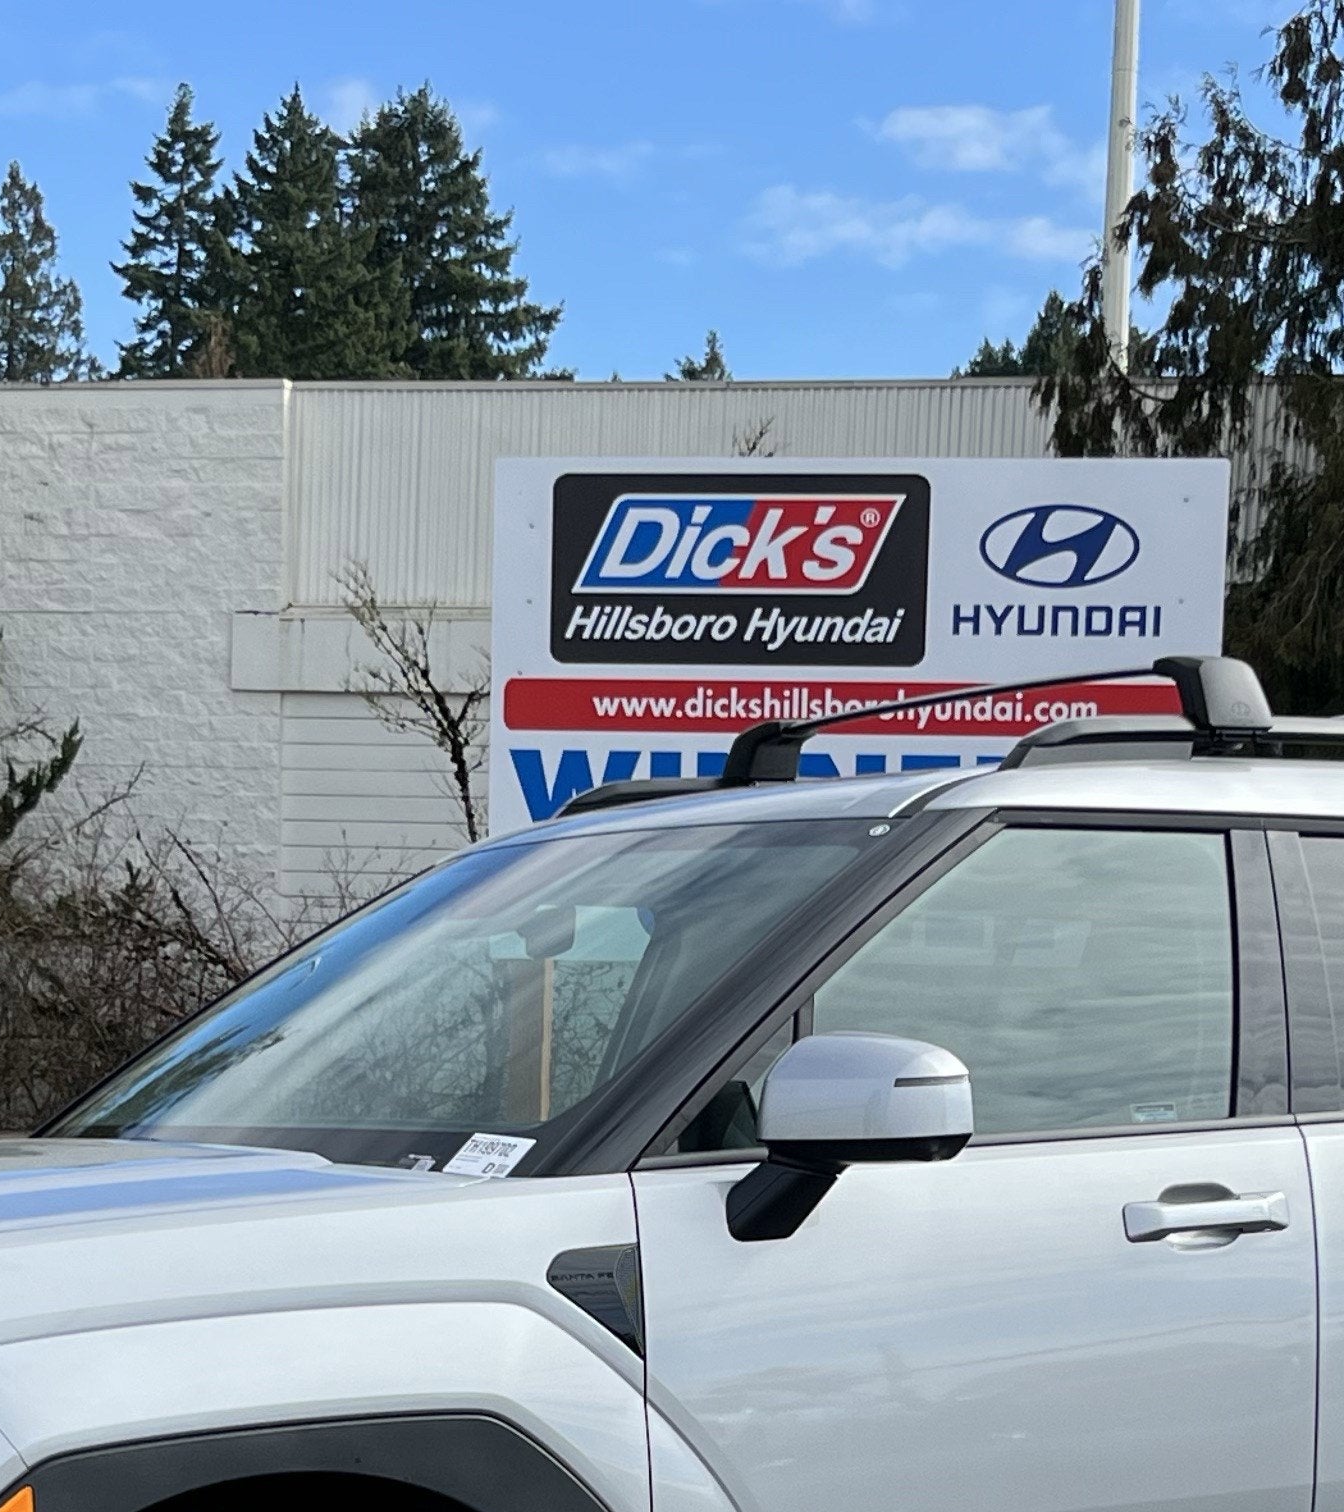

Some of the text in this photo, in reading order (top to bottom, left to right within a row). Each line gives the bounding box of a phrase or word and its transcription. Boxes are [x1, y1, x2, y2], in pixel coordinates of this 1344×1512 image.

[598, 503, 864, 583] Dick's
[565, 605, 906, 651] Hillsboro Hyundai
[952, 604, 1162, 637] HYUNDAI
